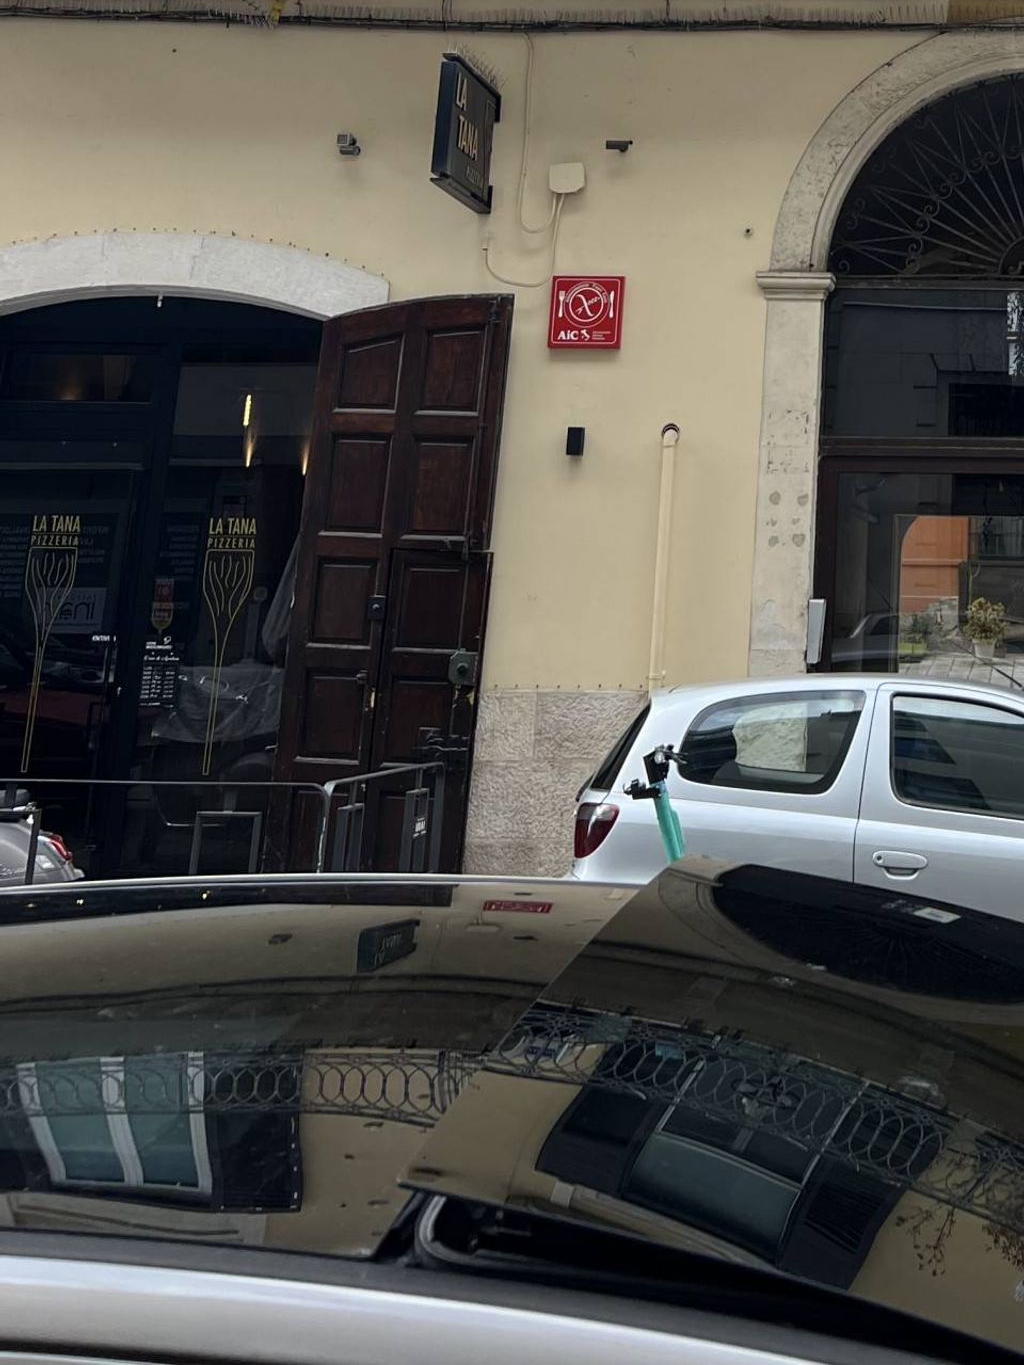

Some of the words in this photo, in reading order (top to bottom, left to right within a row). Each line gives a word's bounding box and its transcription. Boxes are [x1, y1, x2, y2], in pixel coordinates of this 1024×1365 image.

[456, 71, 468, 112] LA
[458, 114, 479, 162] TANA
[32, 515, 47, 532] LA
[51, 515, 81, 533] TANA
[208, 517, 224, 535] LA
[227, 517, 257, 535] TANA
[30, 535, 79, 546] PIZZERIA
[207, 538, 256, 549] PIZZERIA
